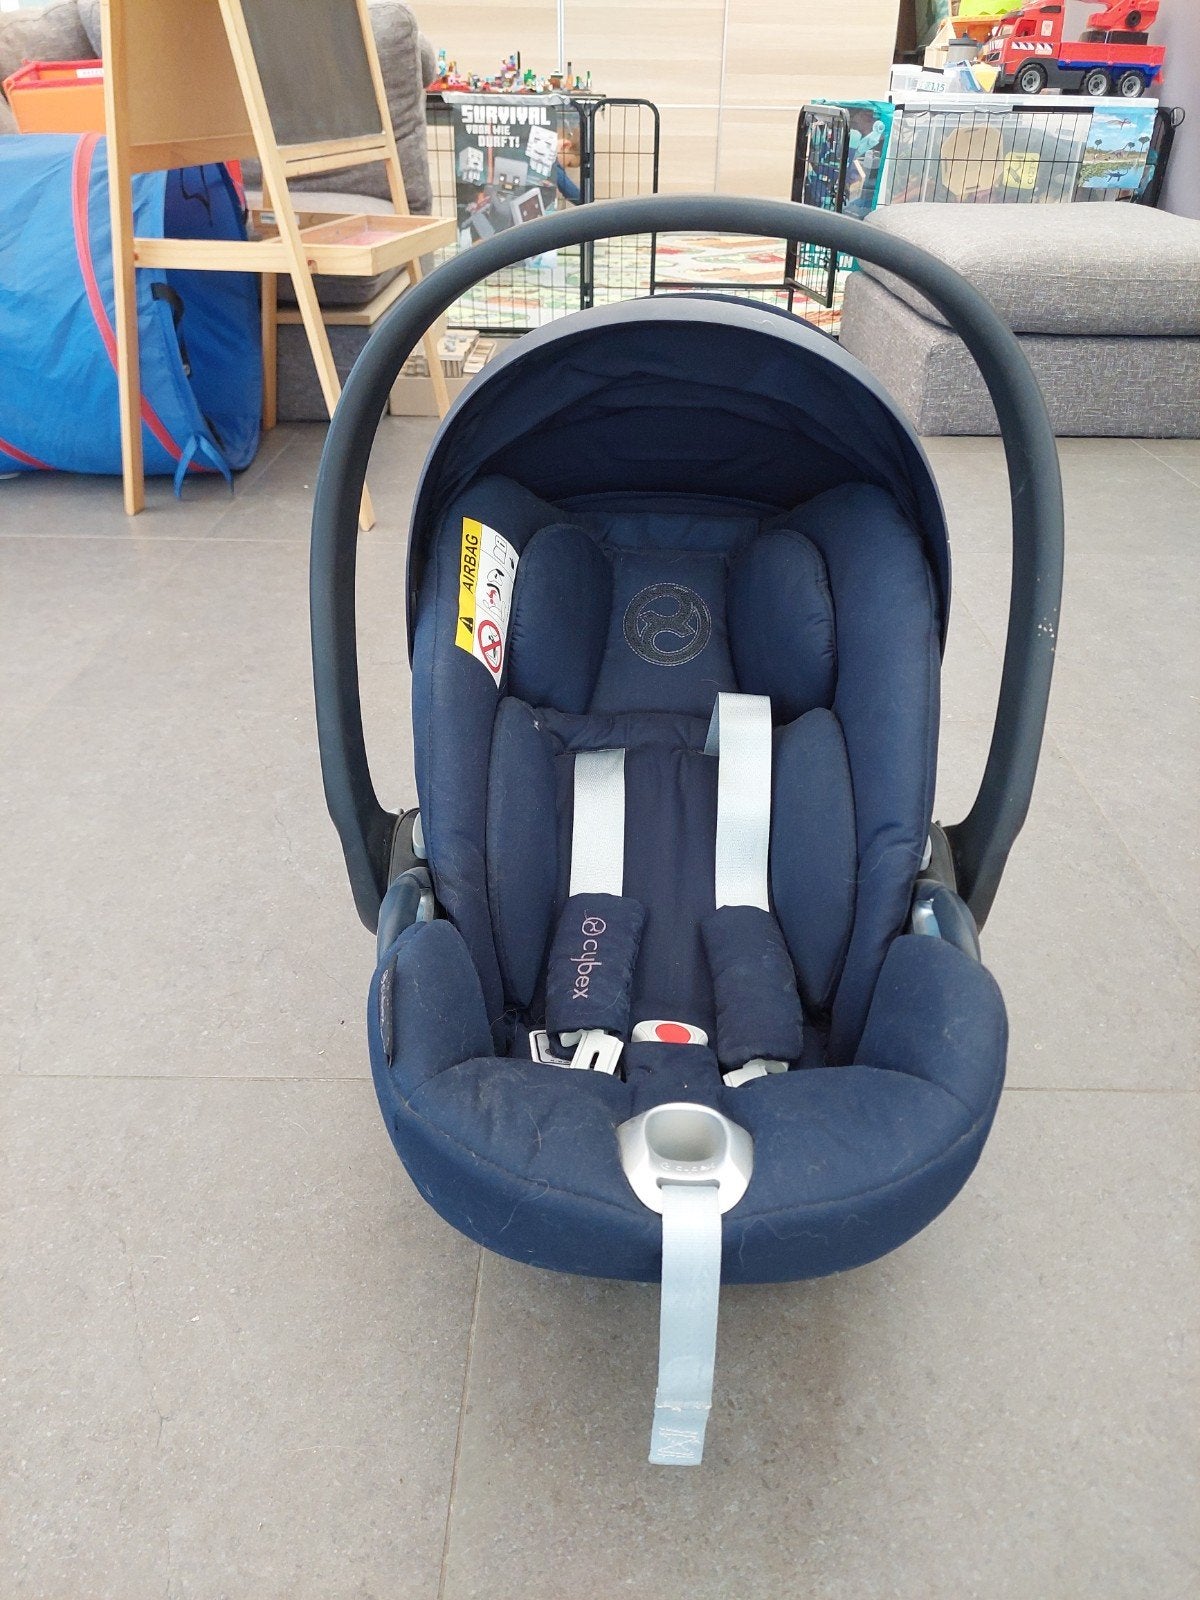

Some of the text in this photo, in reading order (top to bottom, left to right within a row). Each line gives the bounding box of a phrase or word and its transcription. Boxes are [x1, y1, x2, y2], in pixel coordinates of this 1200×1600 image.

[461, 104, 551, 126] SURVIVAL
[477, 135, 520, 148] DURFT!
[492, 125, 511, 136] WIE
[462, 533, 479, 595] AIRBAG
[570, 939, 603, 1000] cybex
